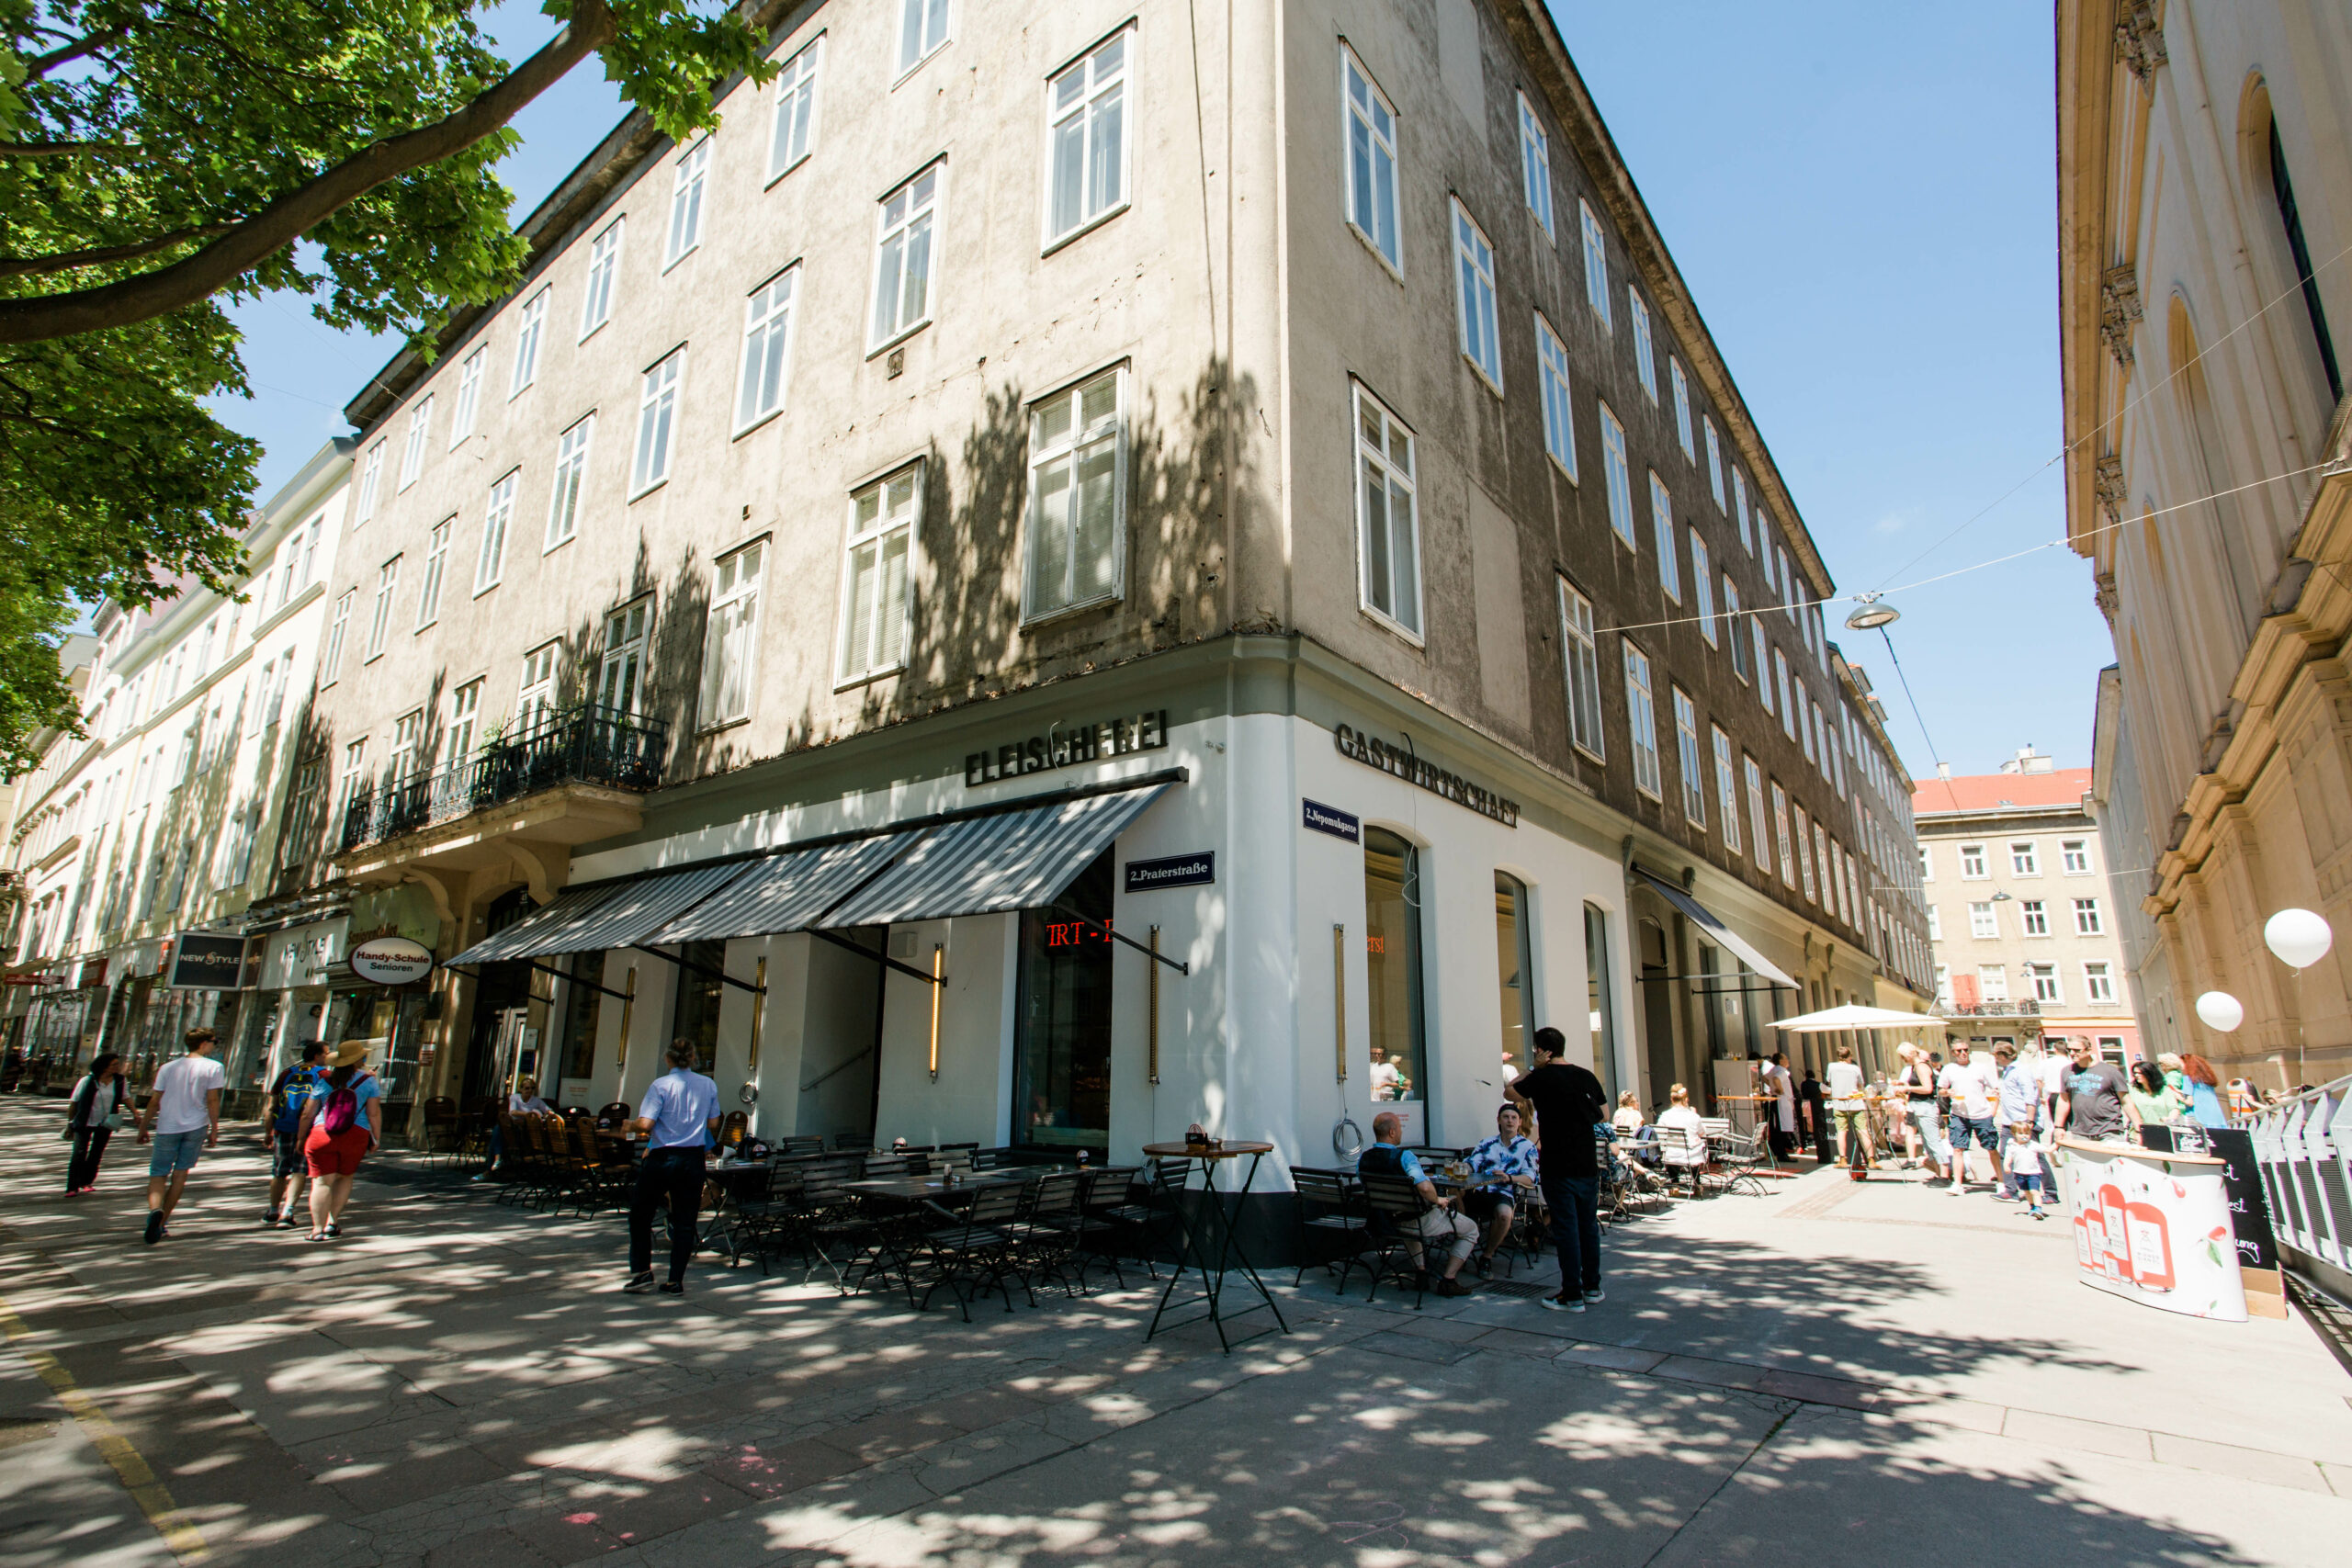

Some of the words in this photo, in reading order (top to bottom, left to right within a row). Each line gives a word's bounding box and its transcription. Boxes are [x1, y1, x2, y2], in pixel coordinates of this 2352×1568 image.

[966, 709, 1167, 788] FLEISCHEREI
[1335, 723, 1521, 829] GASTWIRTSCHAFT
[179, 953, 206, 963] NEW
[205, 951, 241, 965] STYLE
[356, 951, 430, 964] Handy-Schule
[369, 962, 413, 972] Senioren
